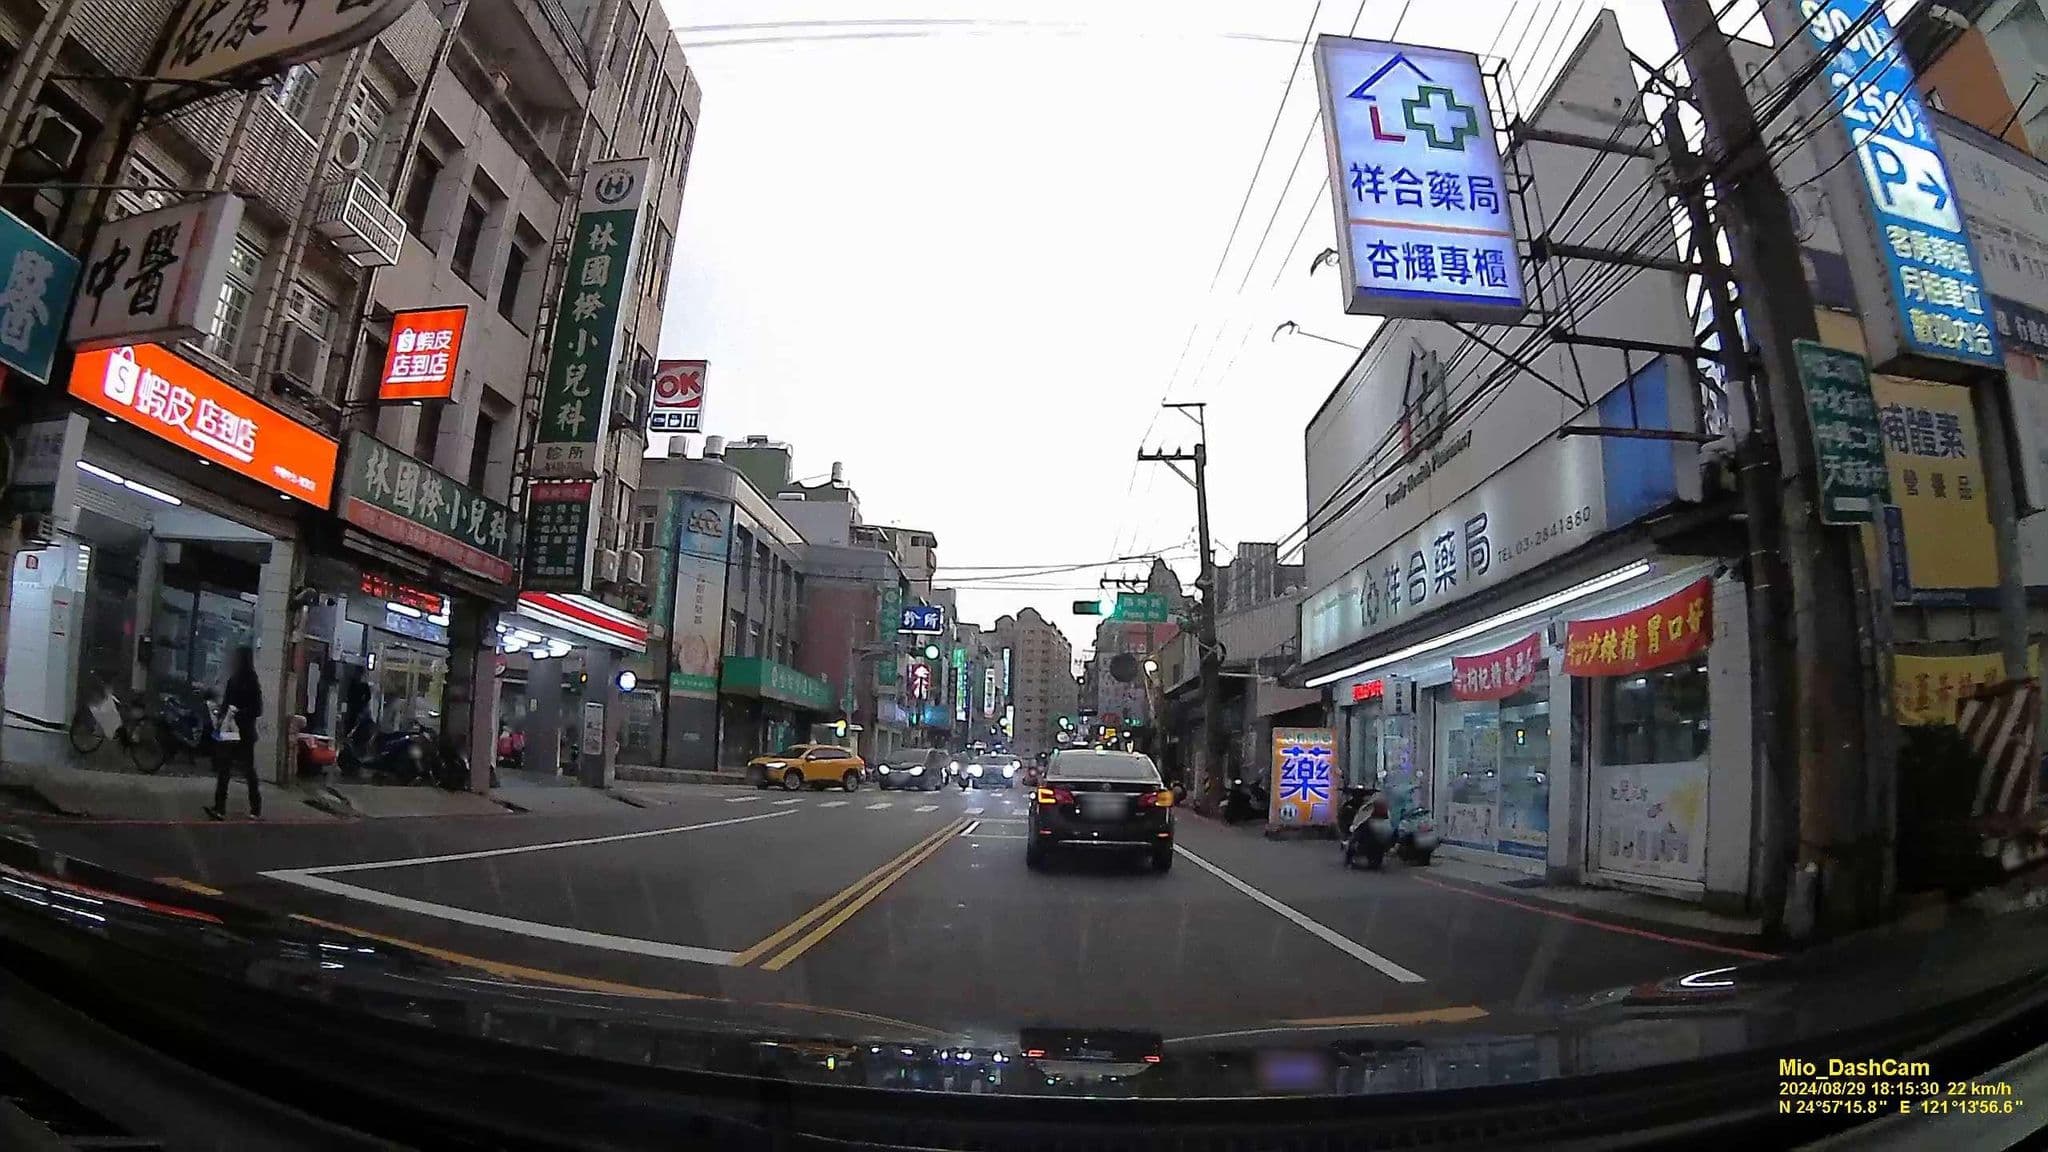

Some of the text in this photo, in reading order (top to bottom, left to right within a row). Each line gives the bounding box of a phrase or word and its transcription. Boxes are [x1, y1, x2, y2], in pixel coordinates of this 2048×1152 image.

[1831, 72, 1914, 138] 250
[1349, 161, 1500, 215] 祥合藥局
[84, 220, 182, 327] 中醫
[1366, 239, 1508, 289] 杏輝專櫃
[391, 352, 449, 376] 店到店
[414, 329, 453, 351] 蝦皮
[135, 368, 259, 455] 蝦皮 店到店
[656, 371, 701, 399] OK
[1383, 511, 1491, 619] 祥合藥局
[904, 610, 938, 630] 診所
[1280, 746, 1330, 801] 藥
